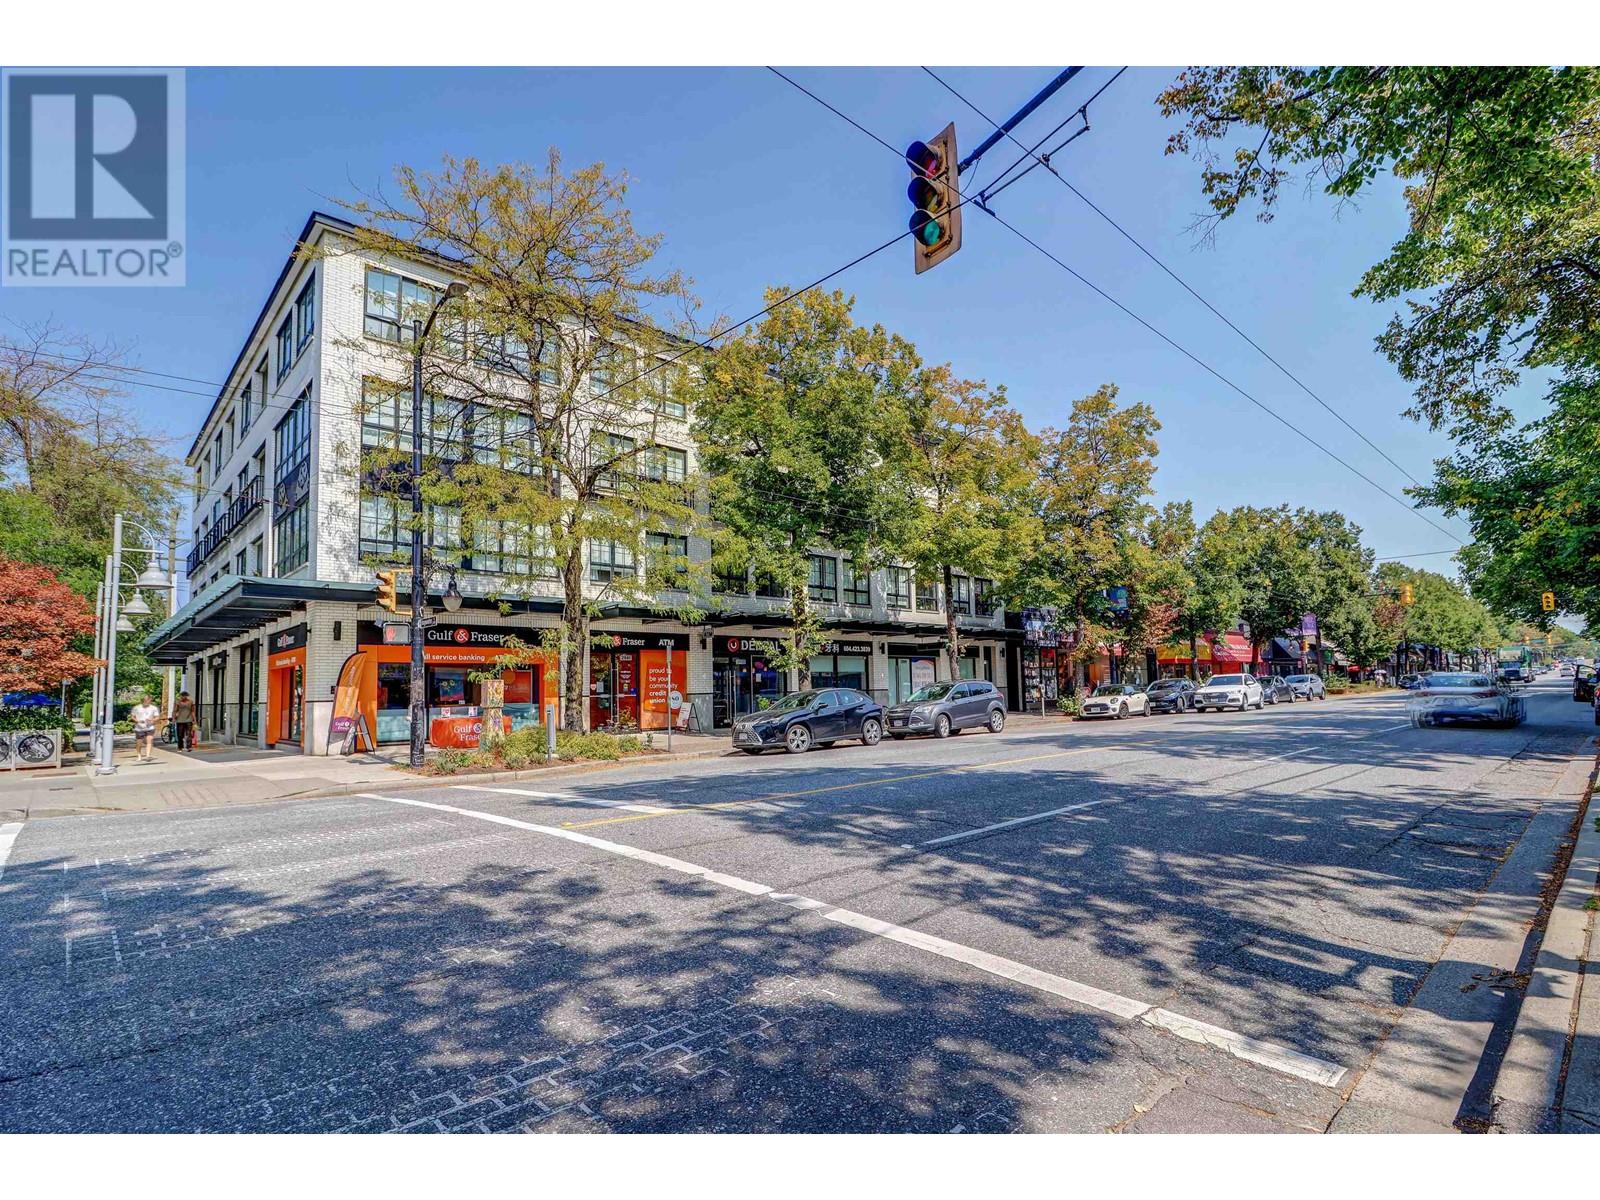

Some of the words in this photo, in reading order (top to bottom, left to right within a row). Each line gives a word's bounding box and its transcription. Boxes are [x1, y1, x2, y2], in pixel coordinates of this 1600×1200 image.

[427, 630, 454, 641] Gulf
[470, 631, 505, 642] Fraser
[622, 637, 645, 646] Fraser
[458, 654, 486, 662] banking
[453, 725, 471, 733] Gulf
